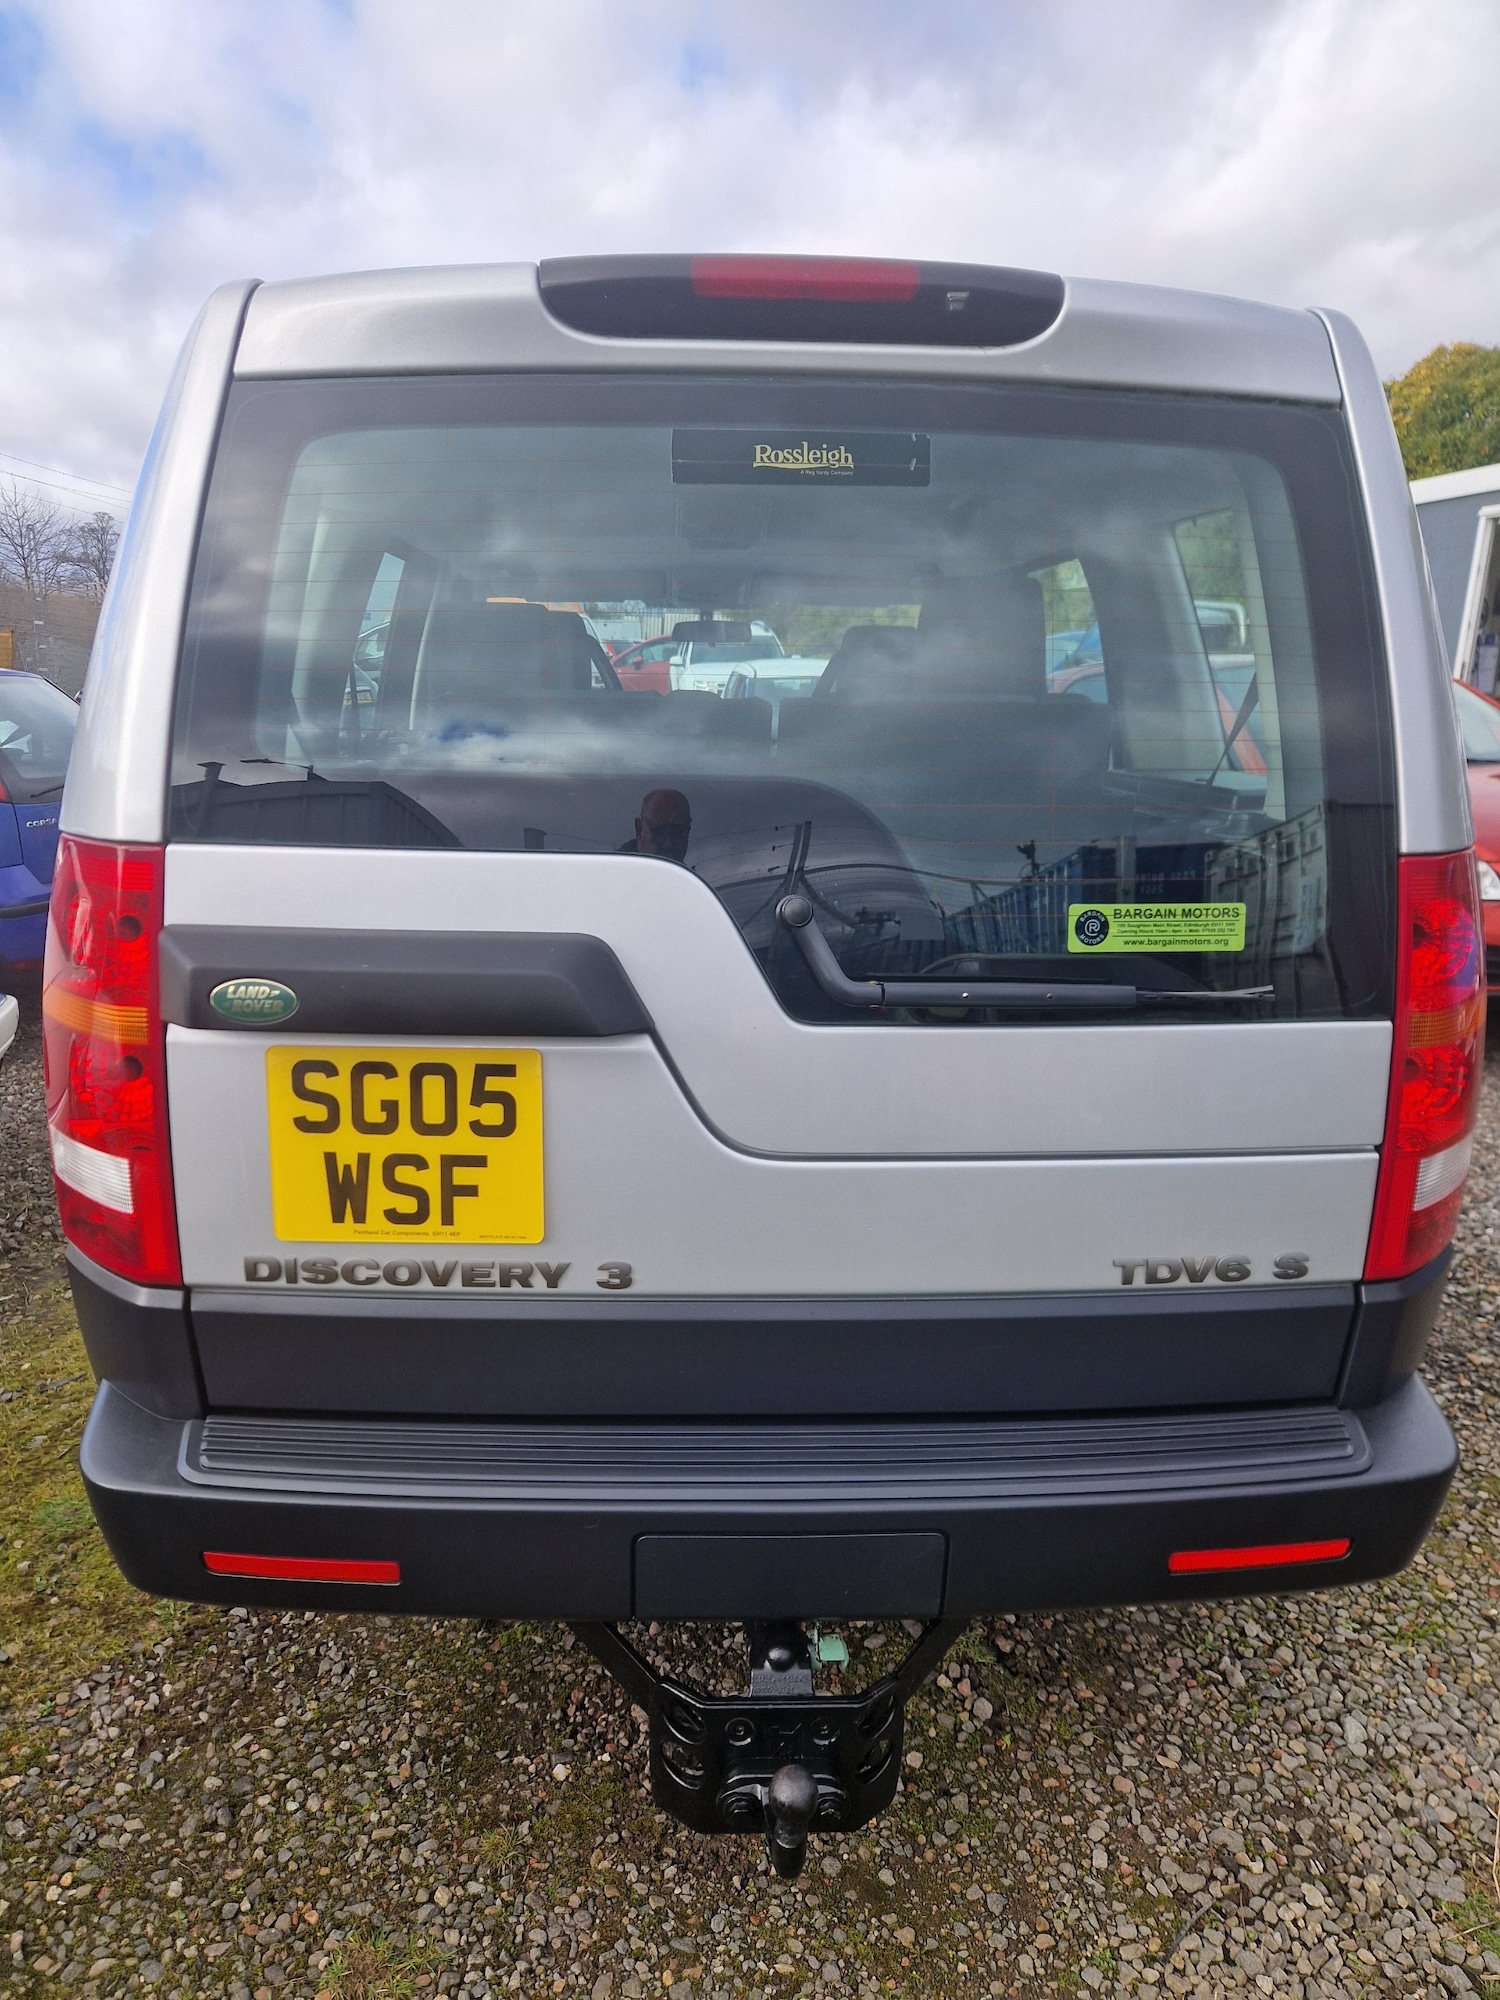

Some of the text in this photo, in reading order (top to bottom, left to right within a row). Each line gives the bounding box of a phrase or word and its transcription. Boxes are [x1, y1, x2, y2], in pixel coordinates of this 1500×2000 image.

[753, 441, 854, 468] Rossleigh
[26, 818, 57, 828] CORSA
[1079, 911, 1106, 922] BARGAIN
[1113, 907, 1240, 919] BARGAIN MOTORS
[1079, 934, 1105, 944] MOTORS
[1123, 938, 1229, 947] www.bargainmotors.org
[291, 1059, 518, 1138] SG05
[323, 1151, 489, 1226] WSF
[243, 1256, 634, 1290] DISCOVERY 3
[1112, 1251, 1310, 1286] TDV6 S
